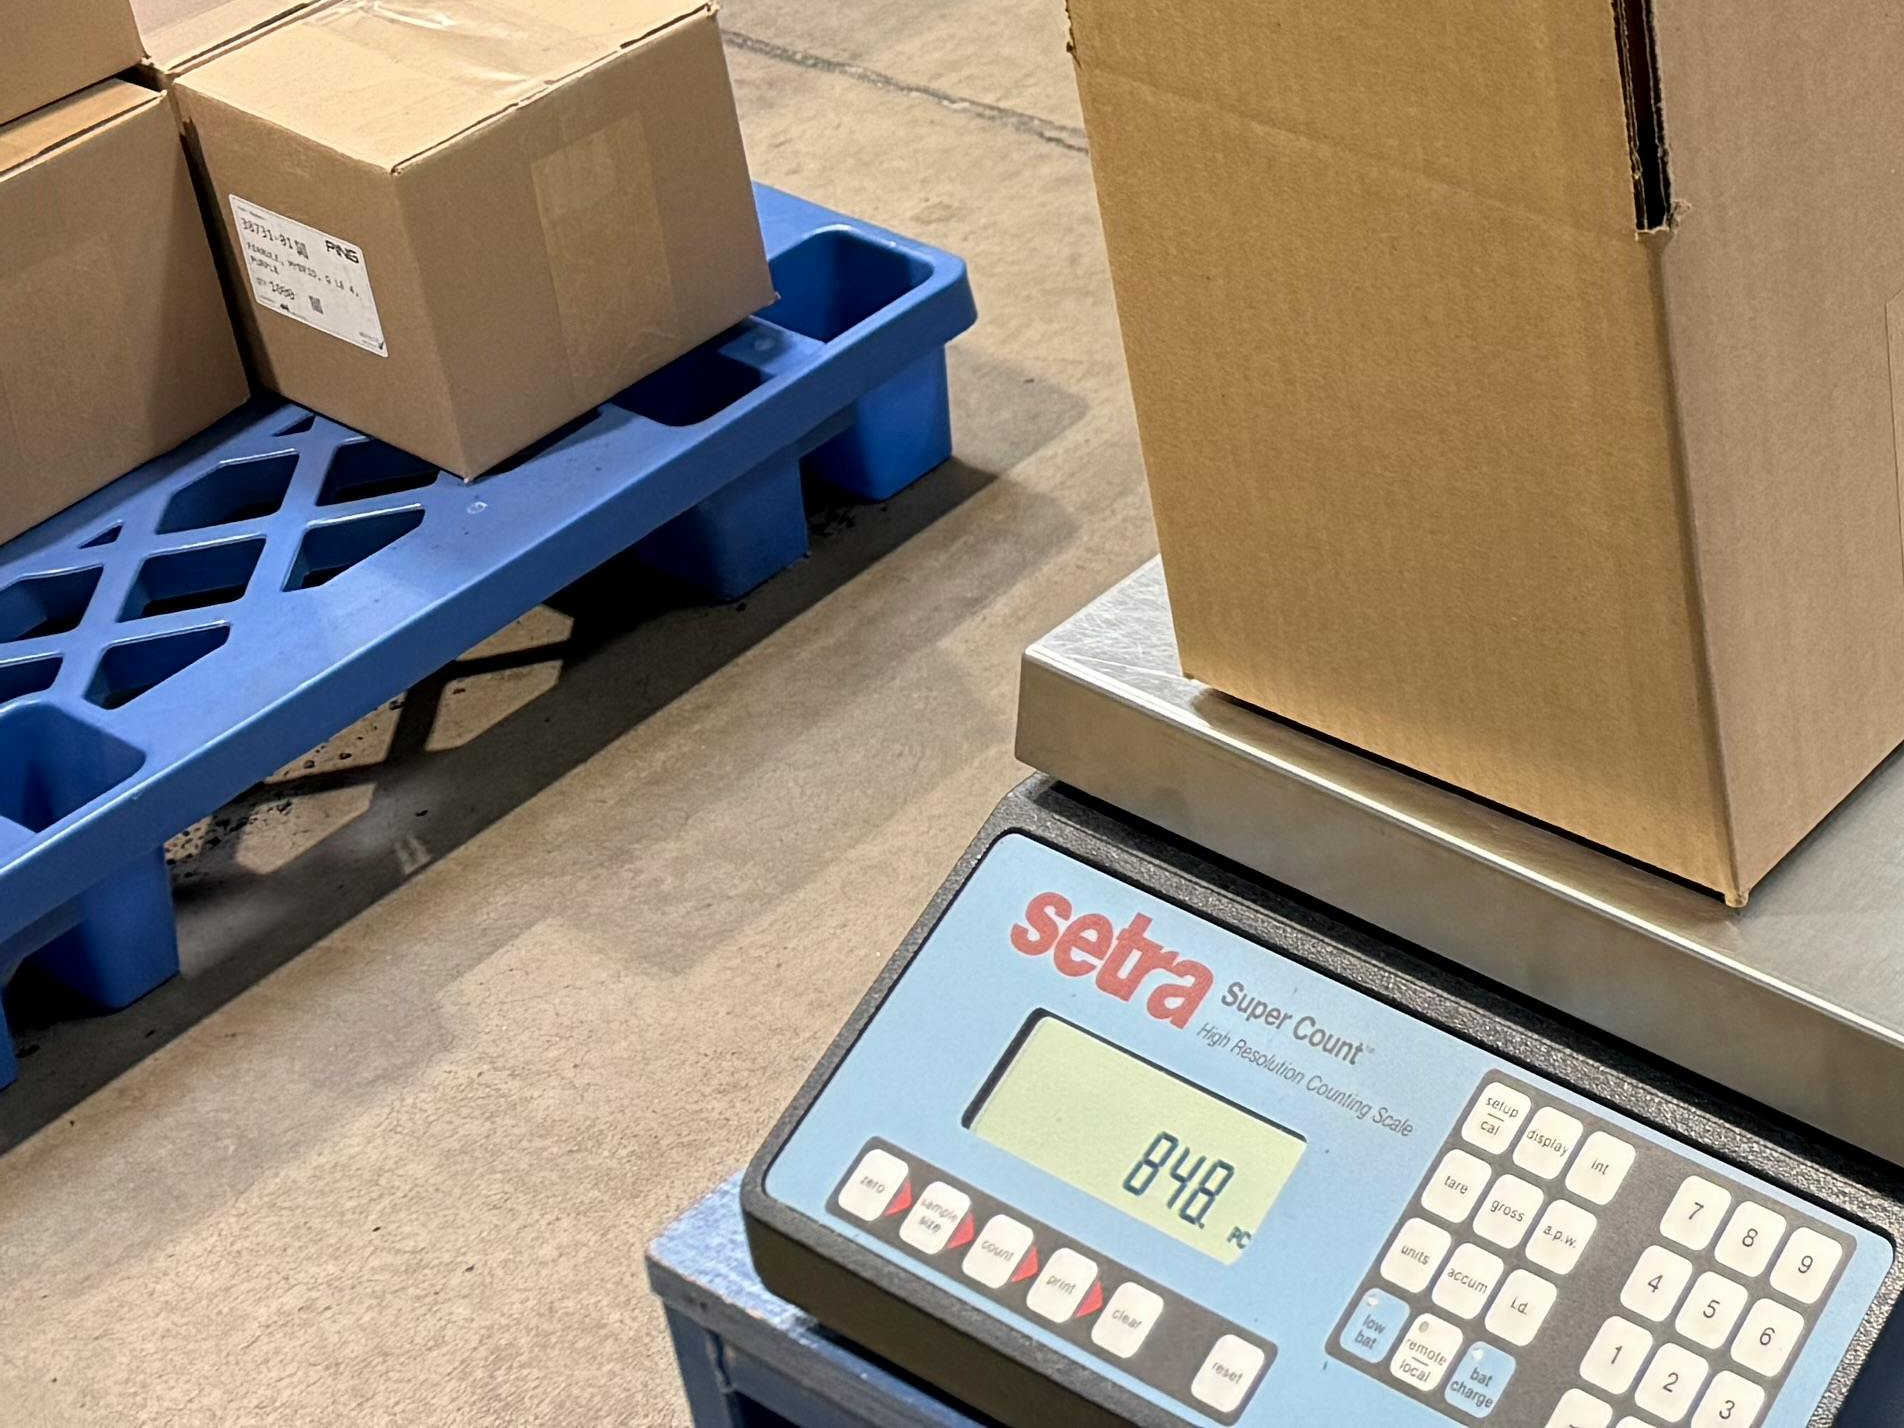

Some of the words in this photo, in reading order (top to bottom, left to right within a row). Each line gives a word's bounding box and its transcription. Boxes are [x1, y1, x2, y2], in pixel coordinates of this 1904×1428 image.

[1009, 891, 1215, 1031] setra
[1220, 982, 1293, 1030] Super
[1292, 1015, 1367, 1066] Count
[1196, 1022, 1231, 1049] High
[1229, 1038, 1305, 1086] Resolution
[1305, 1075, 1373, 1119] Counting
[1372, 1106, 1414, 1137] Scale
[1486, 1094, 1519, 1119] setup
[1479, 1119, 1501, 1136] cal
[1526, 1128, 1568, 1158] display
[1591, 1158, 1610, 1175] int
[858, 1174, 887, 1195] zero
[1443, 1174, 1469, 1195] tare
[921, 1196, 959, 1223] sample
[1489, 1198, 1526, 1223] gross
[1687, 1201, 1704, 1221] 7
[1741, 1227, 1759, 1248] 8
[980, 1239, 1015, 1263] count
[1400, 1244, 1431, 1266] units
[1797, 1255, 1814, 1274] 9
[1044, 1272, 1077, 1296] print
[1447, 1267, 1488, 1294] accum
[1647, 1274, 1665, 1294] 4
[1111, 1307, 1143, 1331] clear
[1702, 1299, 1721, 1319] 5
[1361, 1314, 1386, 1335] low
[1354, 1331, 1378, 1350] bat
[1758, 1326, 1776, 1346] 6
[1404, 1337, 1448, 1367] remote
[1609, 1344, 1623, 1365] 1
[1211, 1360, 1245, 1386] reset
[1399, 1359, 1432, 1383] local
[1469, 1366, 1494, 1388] bat
[1662, 1371, 1680, 1393] 2
[1449, 1379, 1494, 1409] charge
[1719, 1399, 1736, 1421] 3
